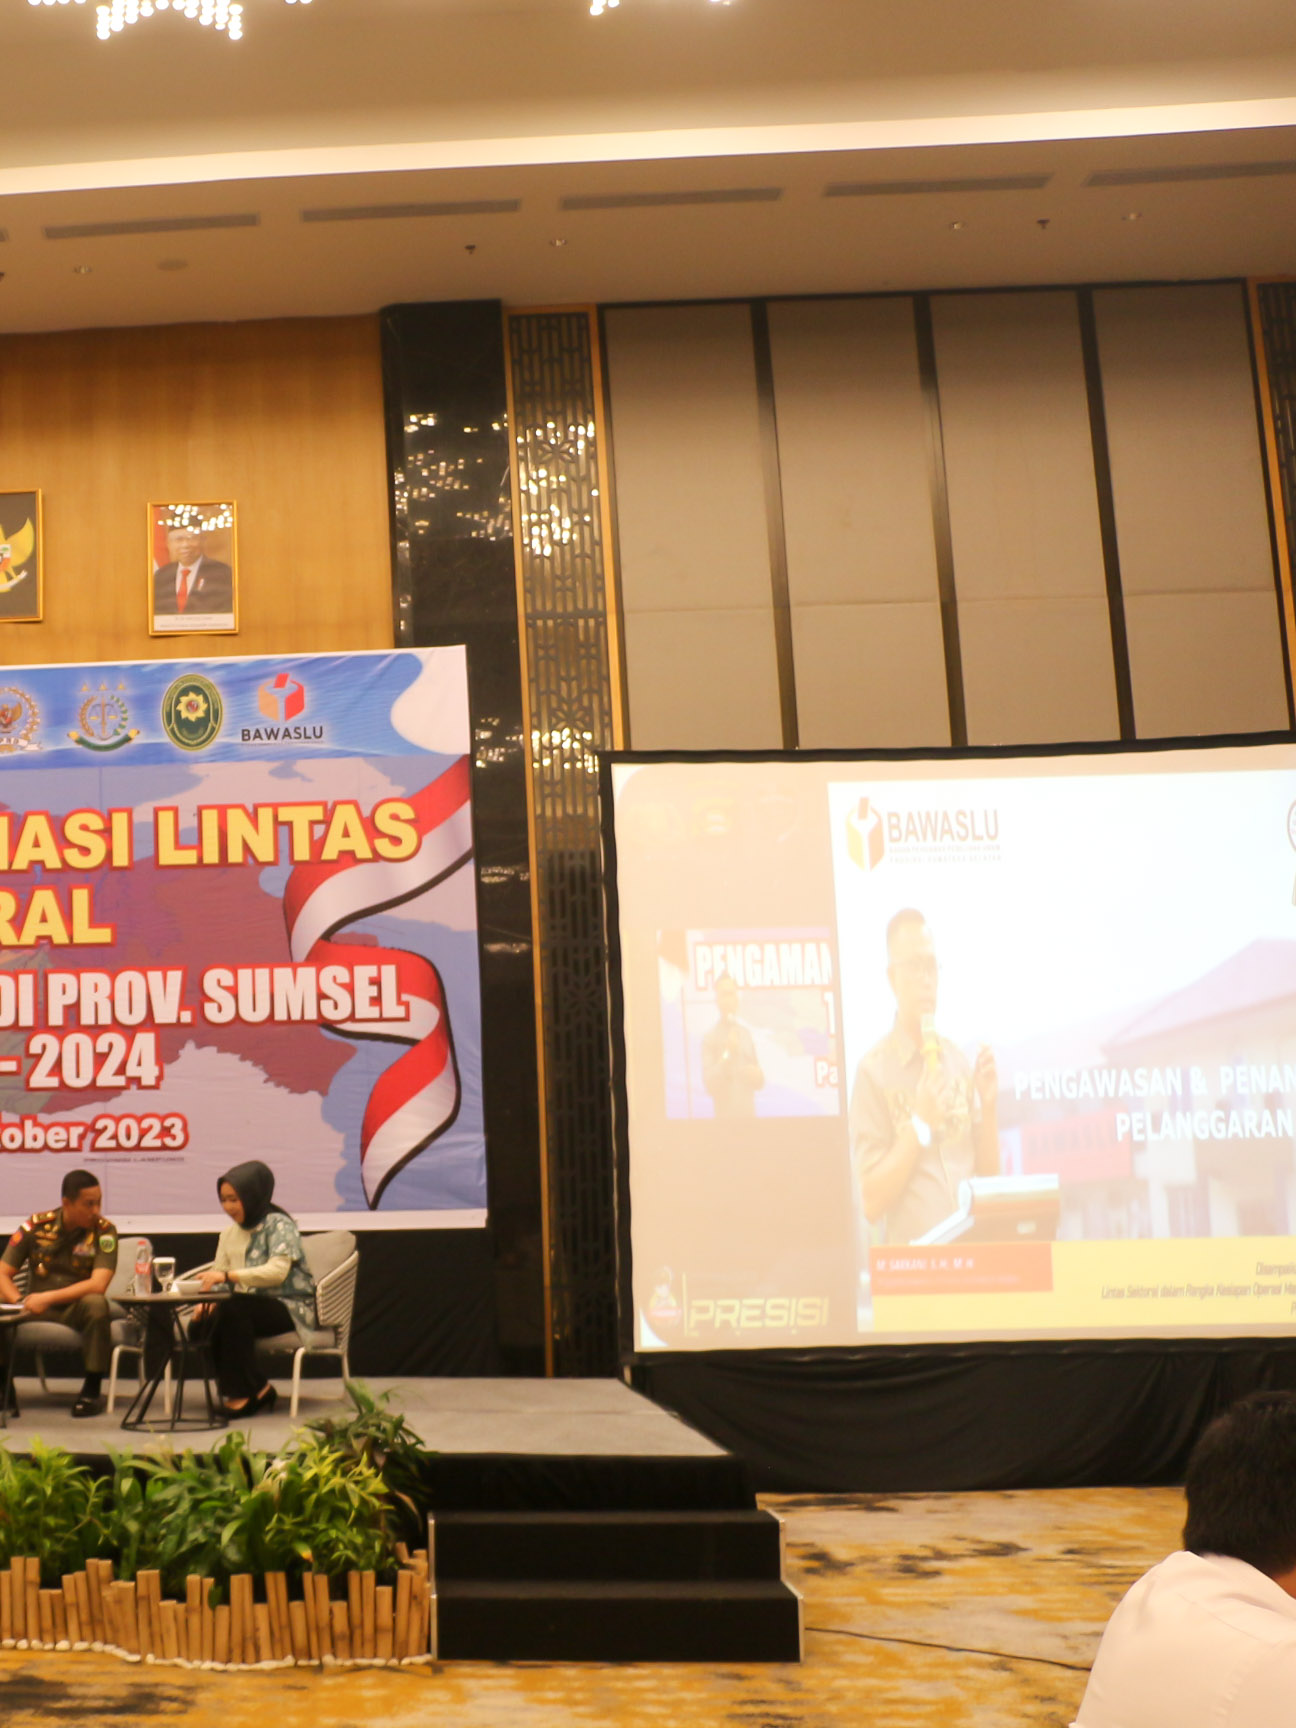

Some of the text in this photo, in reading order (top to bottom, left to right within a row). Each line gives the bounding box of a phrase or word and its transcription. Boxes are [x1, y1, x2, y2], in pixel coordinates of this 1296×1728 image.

[241, 725, 323, 742] BAWASLU
[154, 799, 420, 867] LINTAS
[886, 809, 1000, 843] BAWASLU
[46, 968, 193, 1029] PROV.
[202, 964, 410, 1024] SUMSEL
[25, 1031, 162, 1091] 2024
[1015, 1067, 1182, 1099] PENGAWASAN
[1189, 1066, 1208, 1096] &
[90, 1113, 189, 1150] 2023
[1116, 1109, 1293, 1141] PELANGGARAN
[689, 1295, 830, 1328] PRESISI
